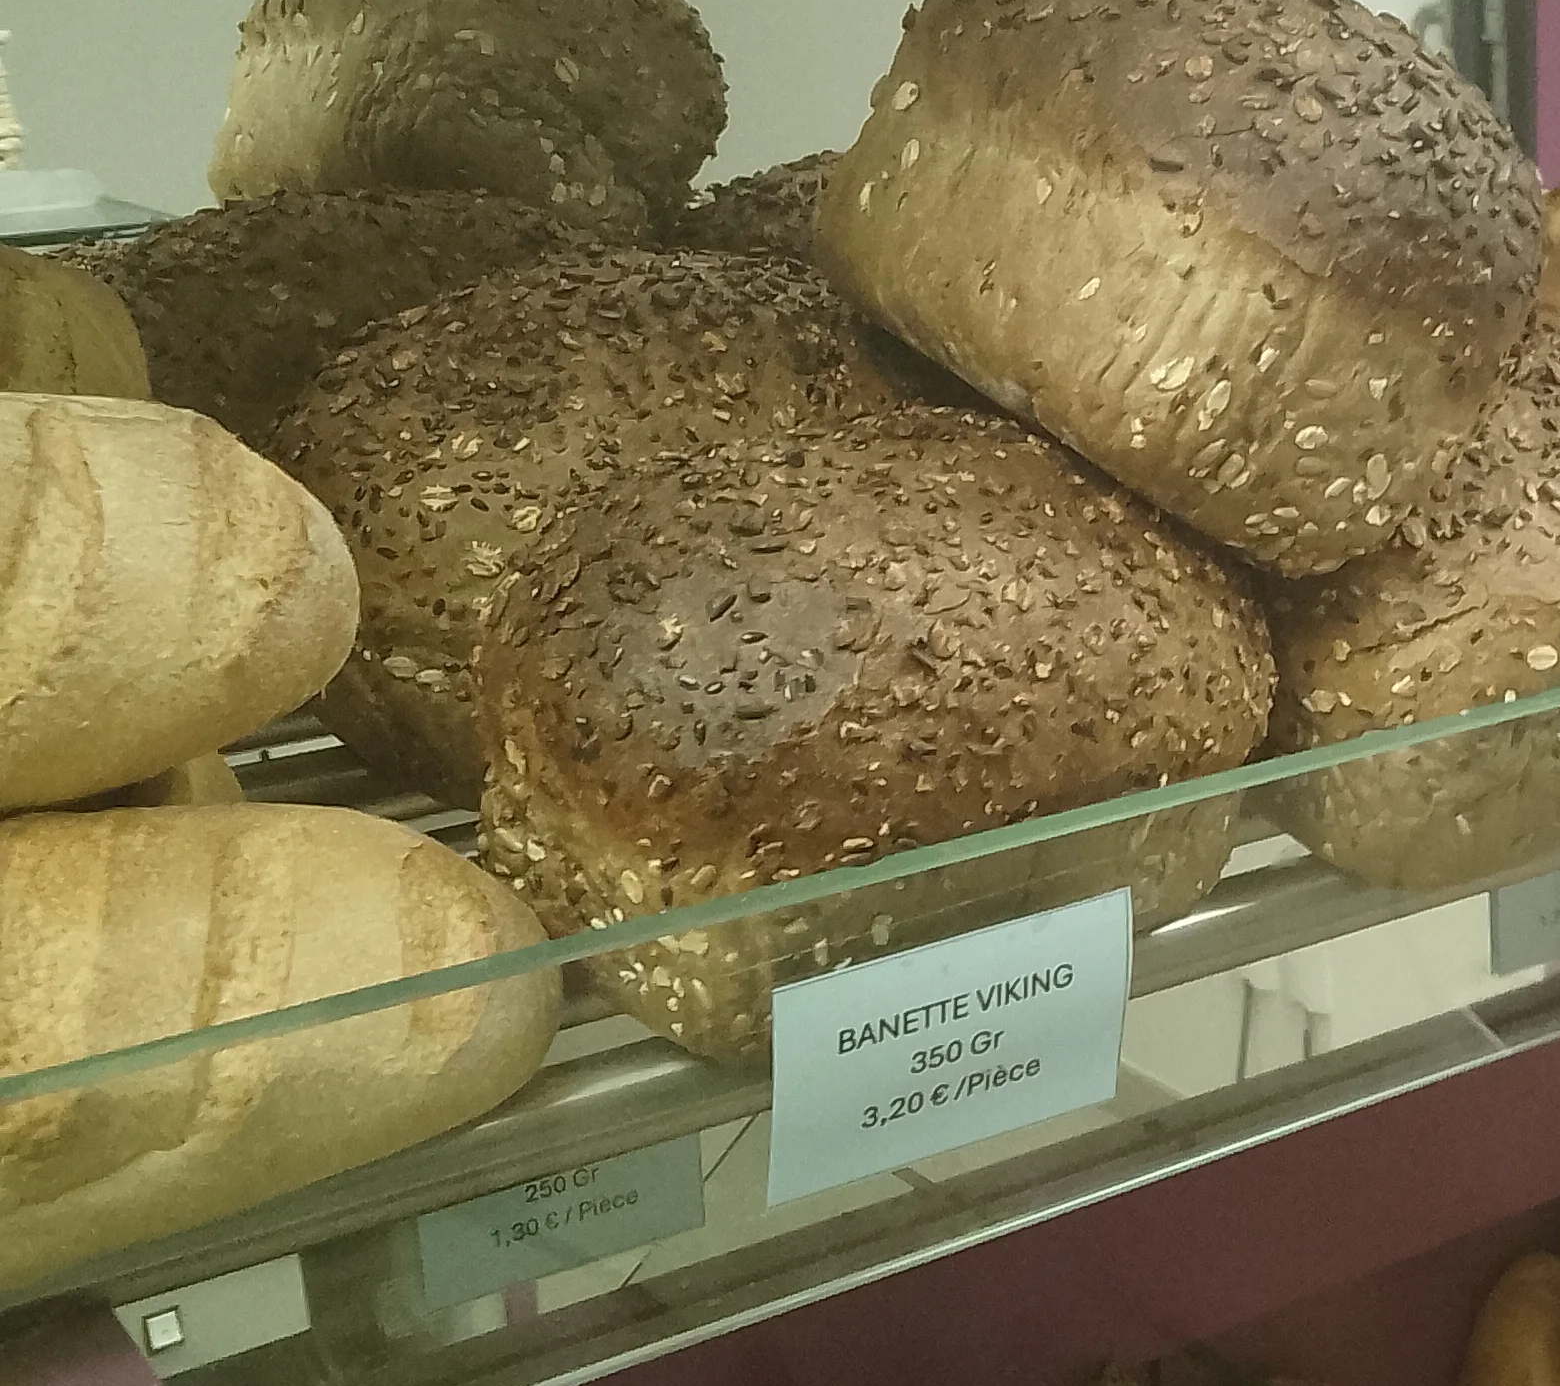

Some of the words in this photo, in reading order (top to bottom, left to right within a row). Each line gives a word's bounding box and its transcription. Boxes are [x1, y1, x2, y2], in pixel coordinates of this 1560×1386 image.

[837, 993, 970, 1055] BANETTE
[976, 963, 1075, 1013] VIKING
[909, 1038, 962, 1075] 350
[970, 1028, 1005, 1056] Gr
[860, 1090, 925, 1129] 3,20
[929, 1083, 950, 1108] €
[953, 1057, 1042, 1101] /Pièce
[524, 1175, 566, 1204] 250
[573, 1166, 600, 1188] Gr
[488, 1216, 539, 1249] 1,30
